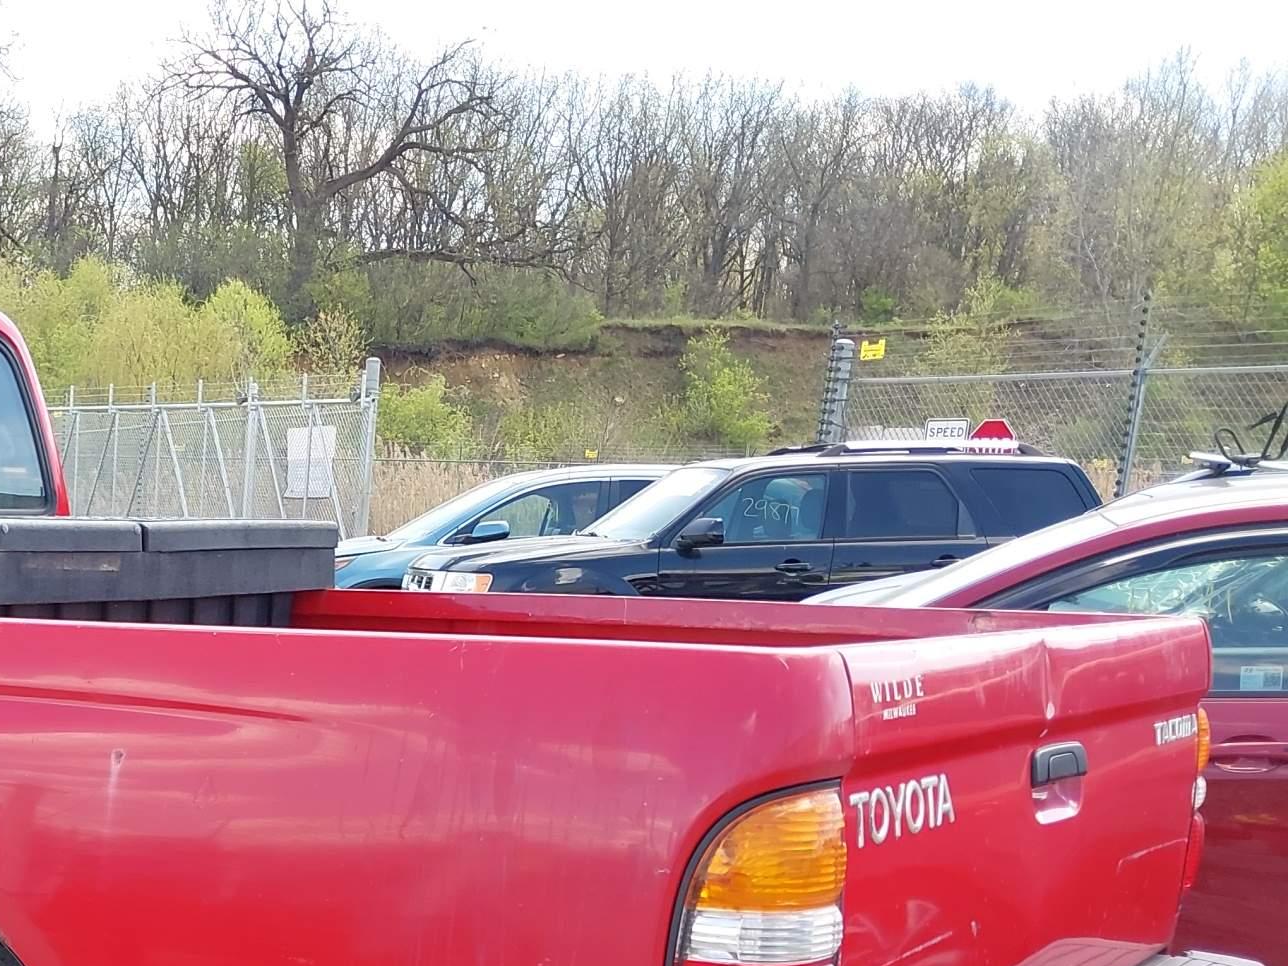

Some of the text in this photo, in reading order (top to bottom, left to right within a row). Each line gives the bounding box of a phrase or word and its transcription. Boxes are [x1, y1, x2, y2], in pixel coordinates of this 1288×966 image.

[928, 426, 965, 438] SPEED
[742, 497, 800, 525] 29877
[870, 674, 924, 703] WILDE
[1153, 713, 1198, 746] TACOMA
[849, 773, 955, 849] TOYOTA
